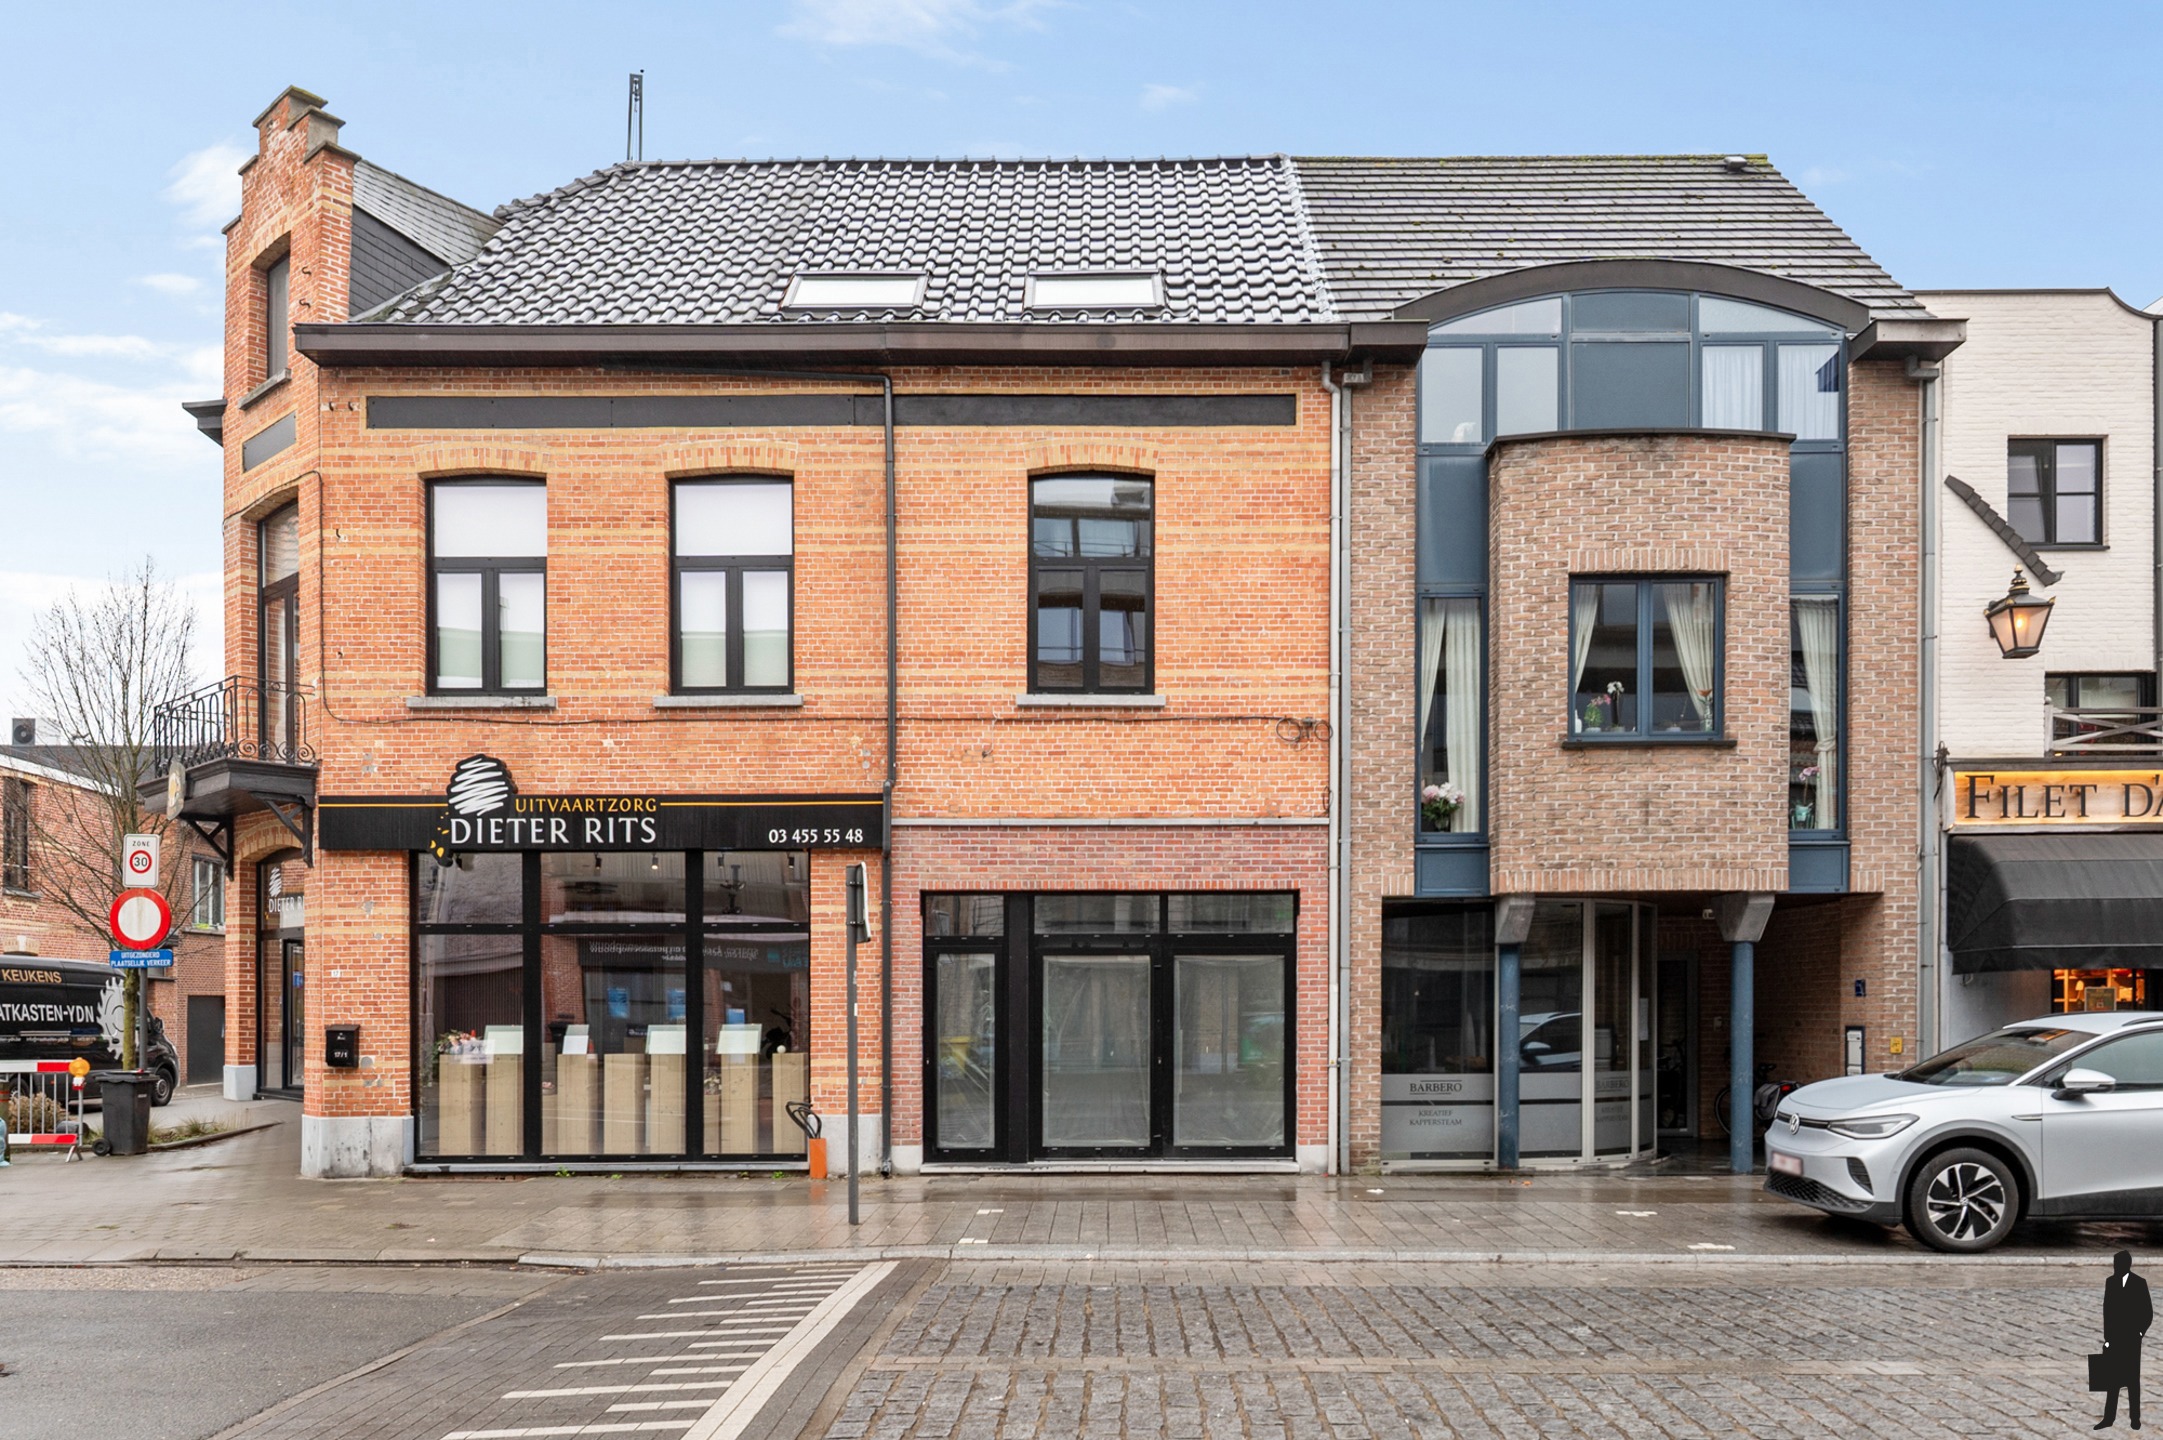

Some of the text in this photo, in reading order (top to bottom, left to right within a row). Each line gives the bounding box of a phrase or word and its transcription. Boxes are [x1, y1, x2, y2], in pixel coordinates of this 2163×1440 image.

[1965, 775, 2097, 819] FILET
[515, 798, 657, 813] UITVAARTZORG
[450, 817, 656, 844] DIETER RITS
[768, 828, 863, 843] 03 455 55 48
[134, 857, 148, 867] 30
[268, 896, 305, 913] DIETER RI
[2, 969, 62, 983] KEUKENS
[1410, 1083, 1462, 1092] BARBERO
